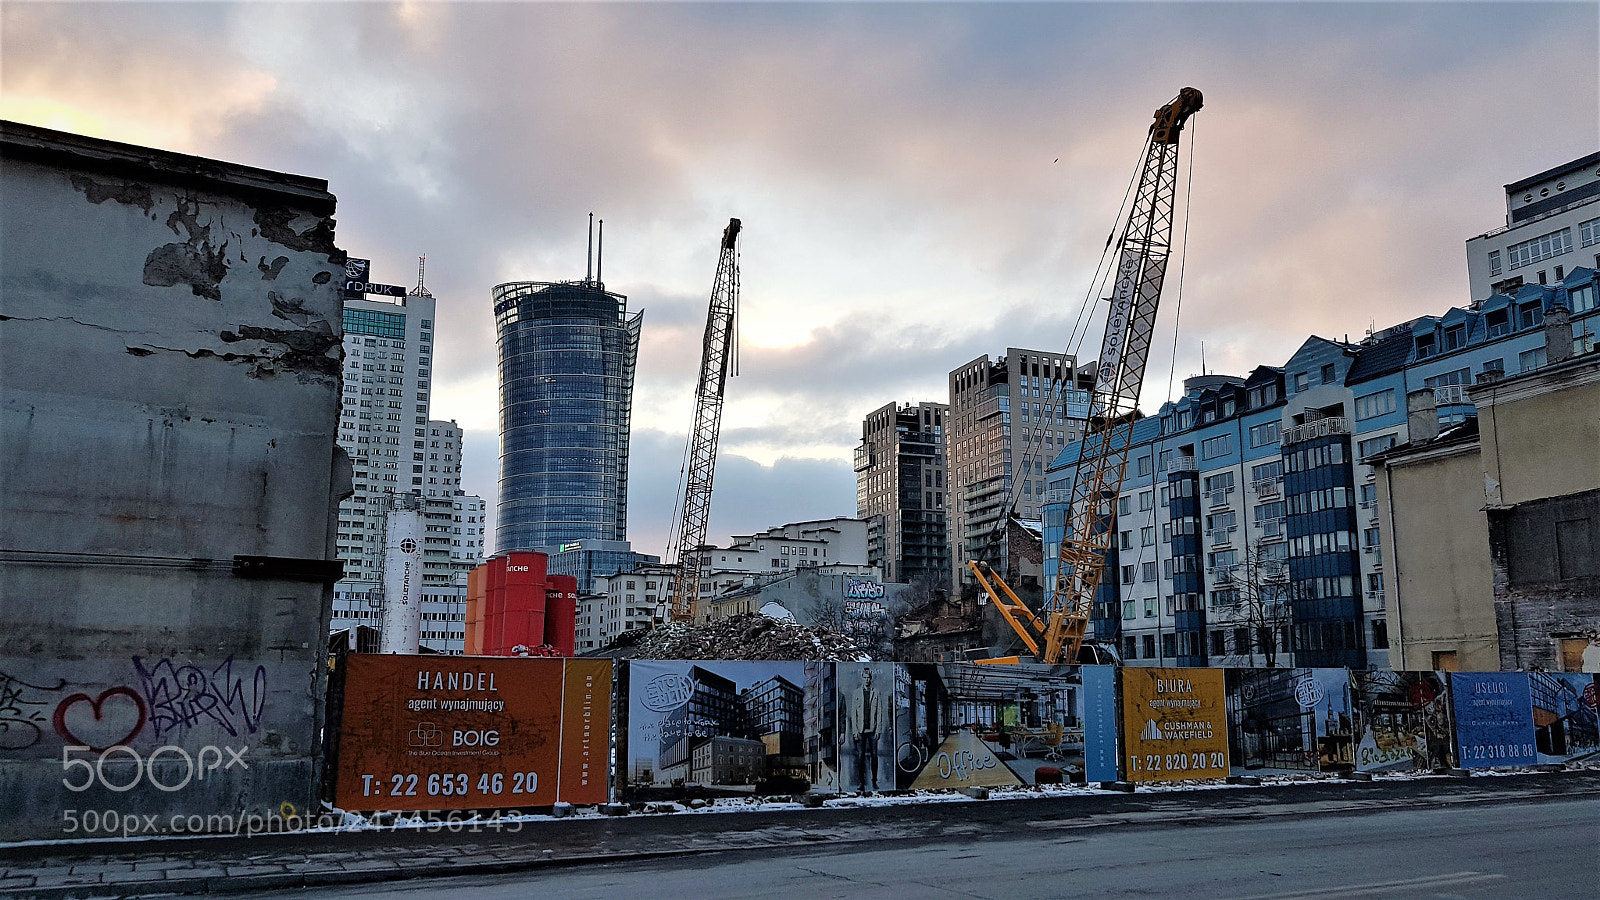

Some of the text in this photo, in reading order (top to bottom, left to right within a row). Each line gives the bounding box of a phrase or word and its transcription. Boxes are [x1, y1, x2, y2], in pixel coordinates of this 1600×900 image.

[417, 671, 498, 691] HANDEL
[1157, 678, 1192, 693] BIURA
[408, 697, 505, 713] agent wynajmujący
[1164, 721, 1213, 730] CUSHMAN &
[452, 729, 500, 747] BOIG
[1164, 730, 1213, 740] WAKEFIELD
[1462, 743, 1534, 760] T: 22 318 88 88
[936, 750, 996, 781] Office
[1131, 752, 1224, 771] T: 22 820 20 20
[361, 771, 538, 797] T: 22 653 46 20
